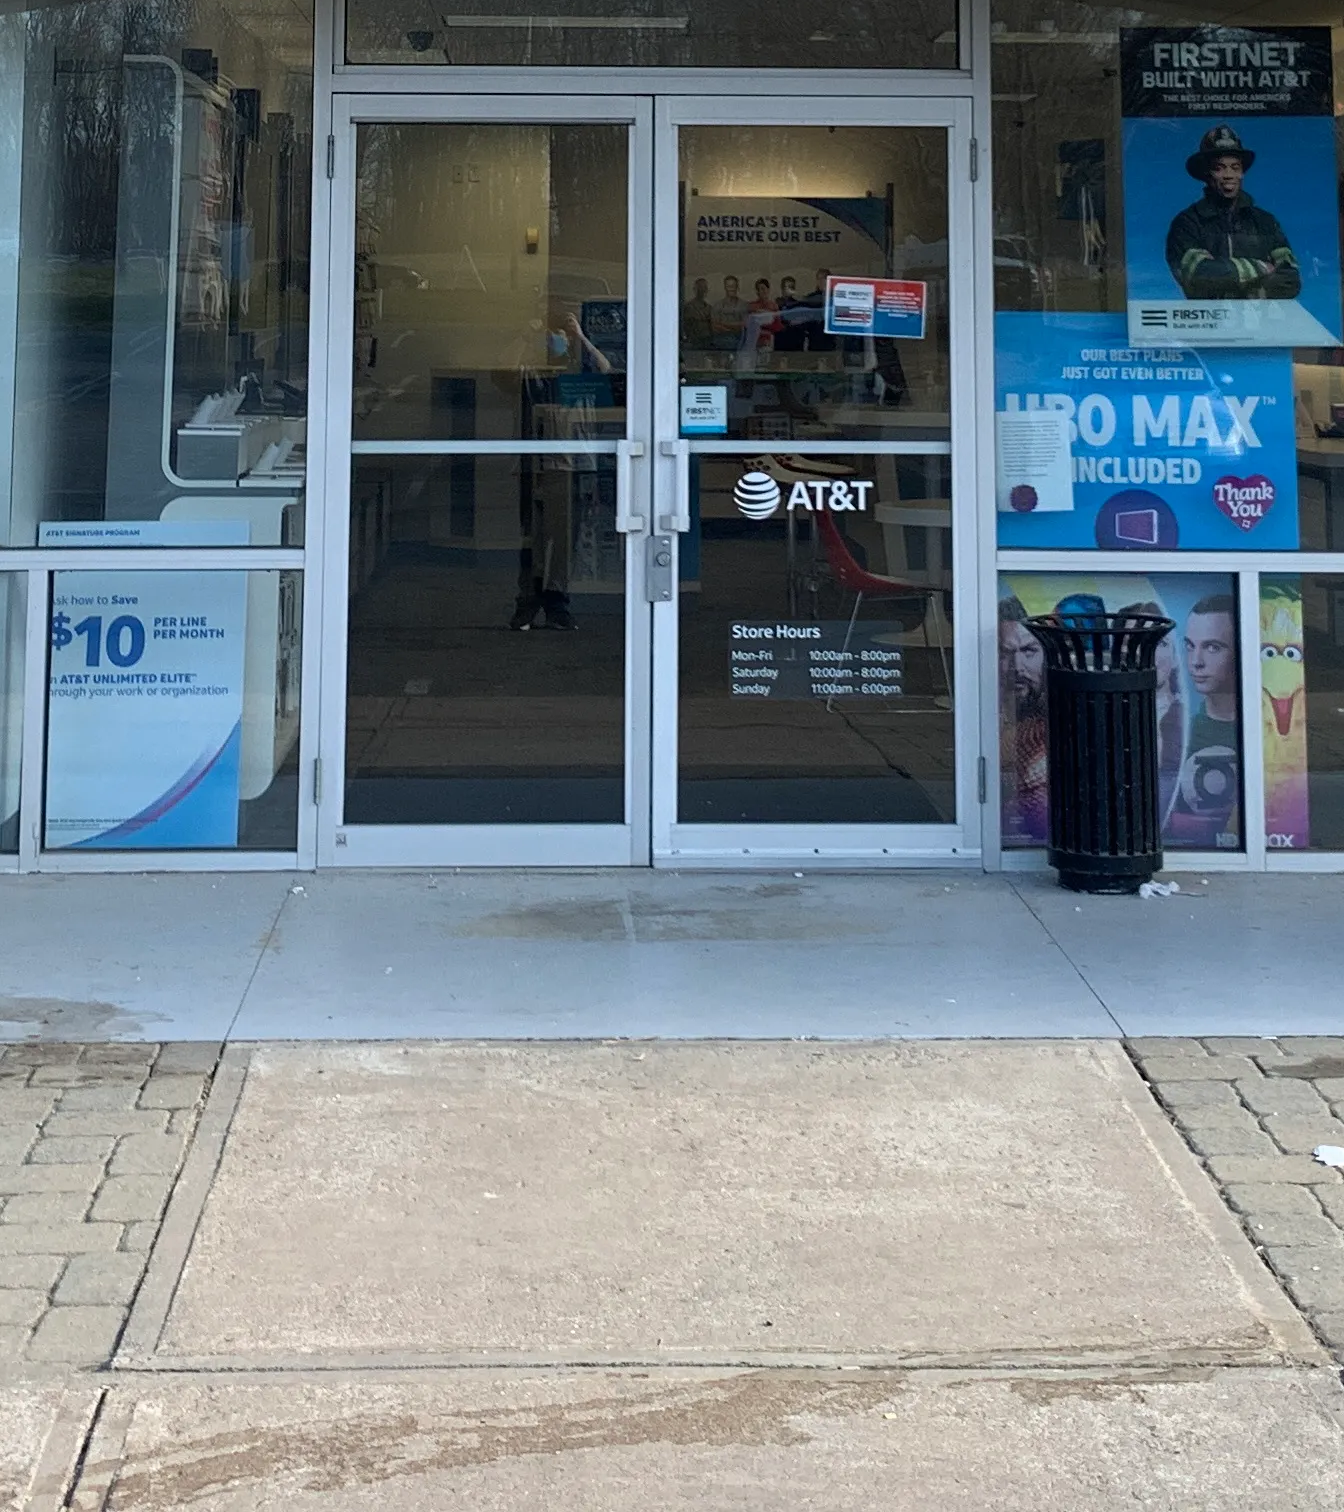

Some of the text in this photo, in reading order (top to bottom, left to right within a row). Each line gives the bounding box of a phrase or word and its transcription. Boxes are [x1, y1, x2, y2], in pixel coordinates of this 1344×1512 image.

[1153, 41, 1306, 68] FIRSTNET
[1142, 70, 1311, 88] BUILT WITH AT&T
[1163, 94, 1180, 102] THE
[1180, 94, 1201, 102] BEST
[1203, 94, 1230, 102] CHOICE
[1232, 94, 1248, 102] FOR
[1188, 102, 1211, 110] FIRST
[697, 215, 820, 229] AMERICA'S BEST
[697, 229, 842, 244] DESERVE OUR BEST
[1080, 348, 1185, 363] OUR BEST PLANS
[1060, 366, 1205, 381] JUST GOT EVEN BETTER
[786, 480, 874, 512] AT&T
[1214, 481, 1274, 502] Thank
[1227, 500, 1264, 518] You
[71, 595, 95, 606] how
[97, 596, 108, 606] to
[111, 595, 139, 605] Save
[153, 616, 208, 628] PER LINE
[153, 628, 225, 640] PER MONTH
[732, 624, 822, 639] Store Hours
[51, 611, 146, 668] $10
[731, 650, 774, 661] Mon-Fri
[808, 650, 854, 661] 10:00am
[860, 650, 901, 663] 8:00pm
[59, 674, 91, 685] AT&T
[93, 673, 158, 685] UNLIMITED
[732, 666, 779, 680] Saturday
[808, 667, 854, 678] 10:00am
[860, 667, 901, 680] 8:00pm
[49, 684, 229, 700] hrough your work or organization
[732, 683, 771, 696] Sunday
[810, 683, 854, 694] 11:00am
[861, 683, 902, 696] 6:00pm
[1265, 833, 1295, 848] ax
